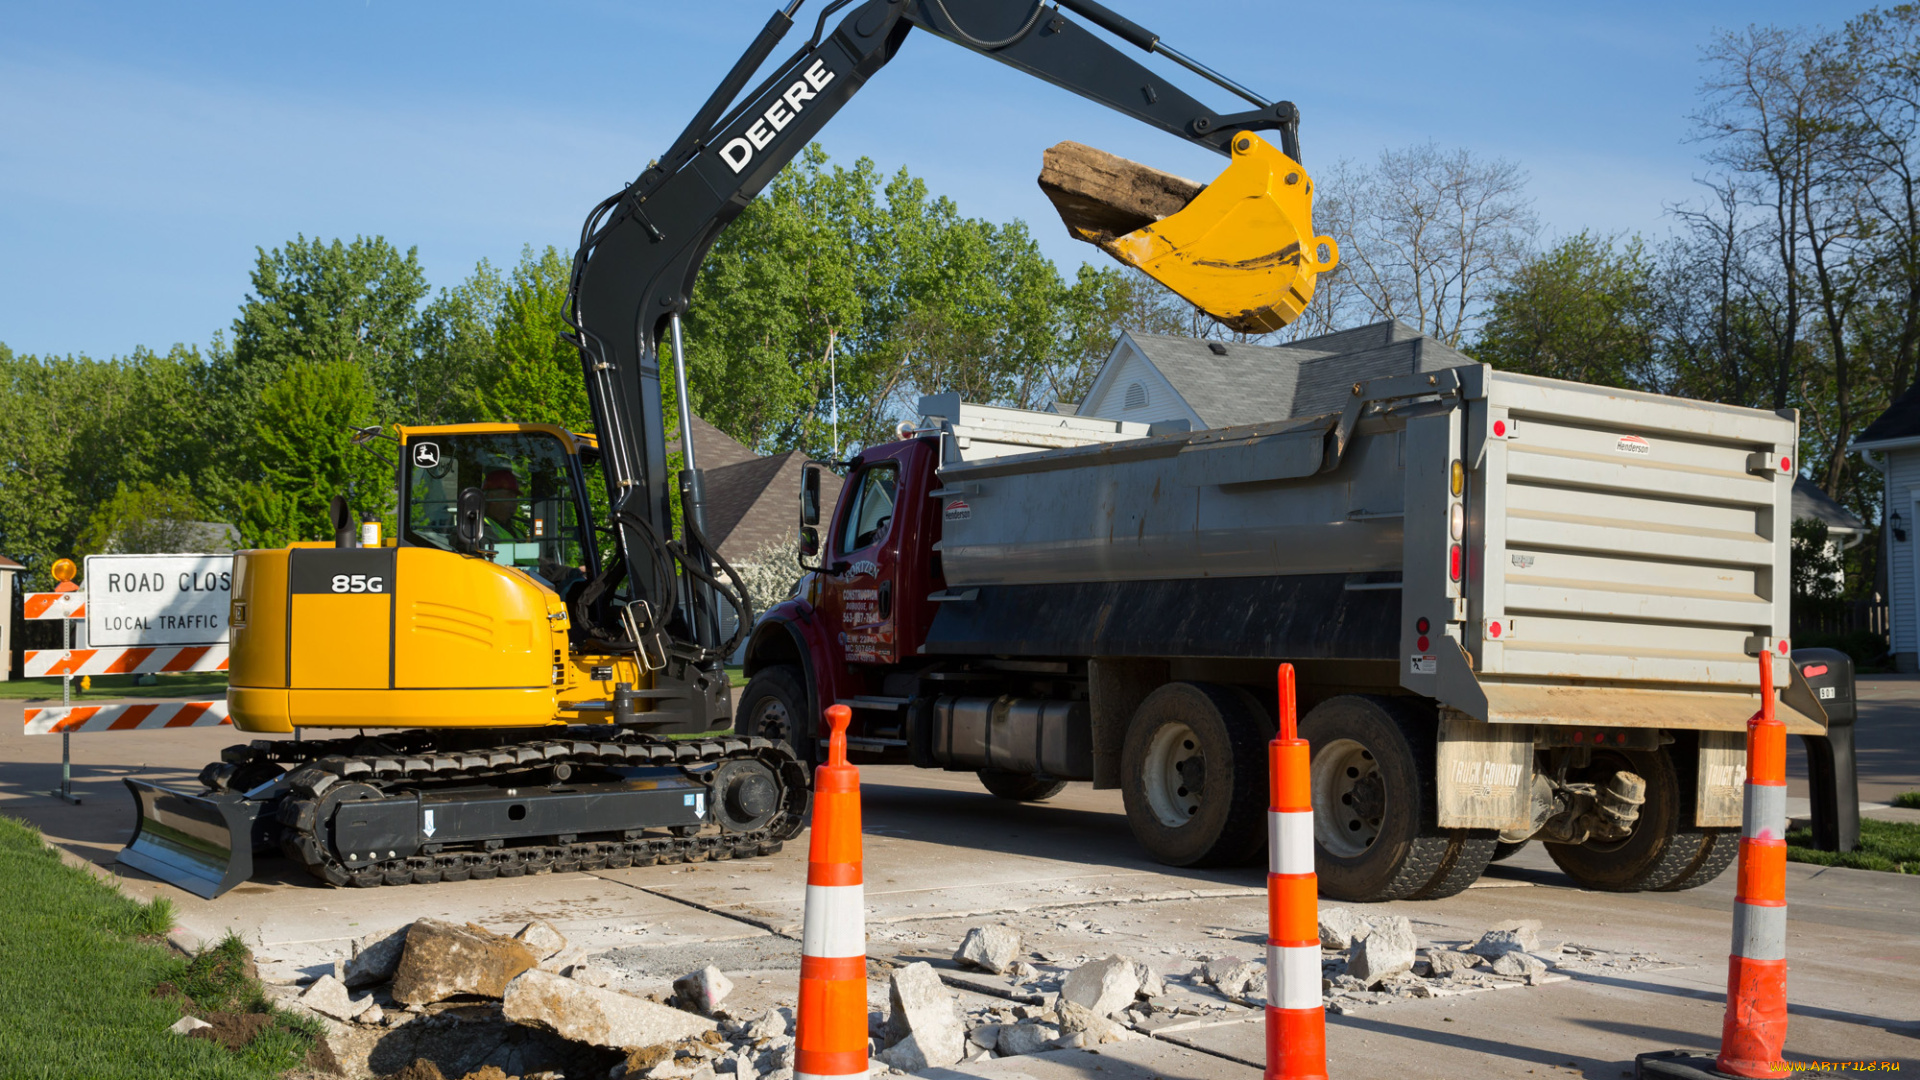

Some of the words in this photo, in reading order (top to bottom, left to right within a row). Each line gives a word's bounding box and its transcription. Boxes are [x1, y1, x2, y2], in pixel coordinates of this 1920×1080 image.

[719, 58, 835, 174] DEERE
[1617, 441, 1649, 453] Henderson
[845, 560, 880, 584] PORTZEN
[109, 572, 164, 592] ROAD
[332, 575, 383, 593] 85G
[843, 589, 878, 600] CONSTRUCTION
[104, 616, 151, 631] LOCAL
[160, 614, 218, 629] TRAFFIC
[845, 644, 854, 652] MC
[1451, 760, 1481, 784] TRUCK
[1482, 760, 1523, 787] COUNTRY
